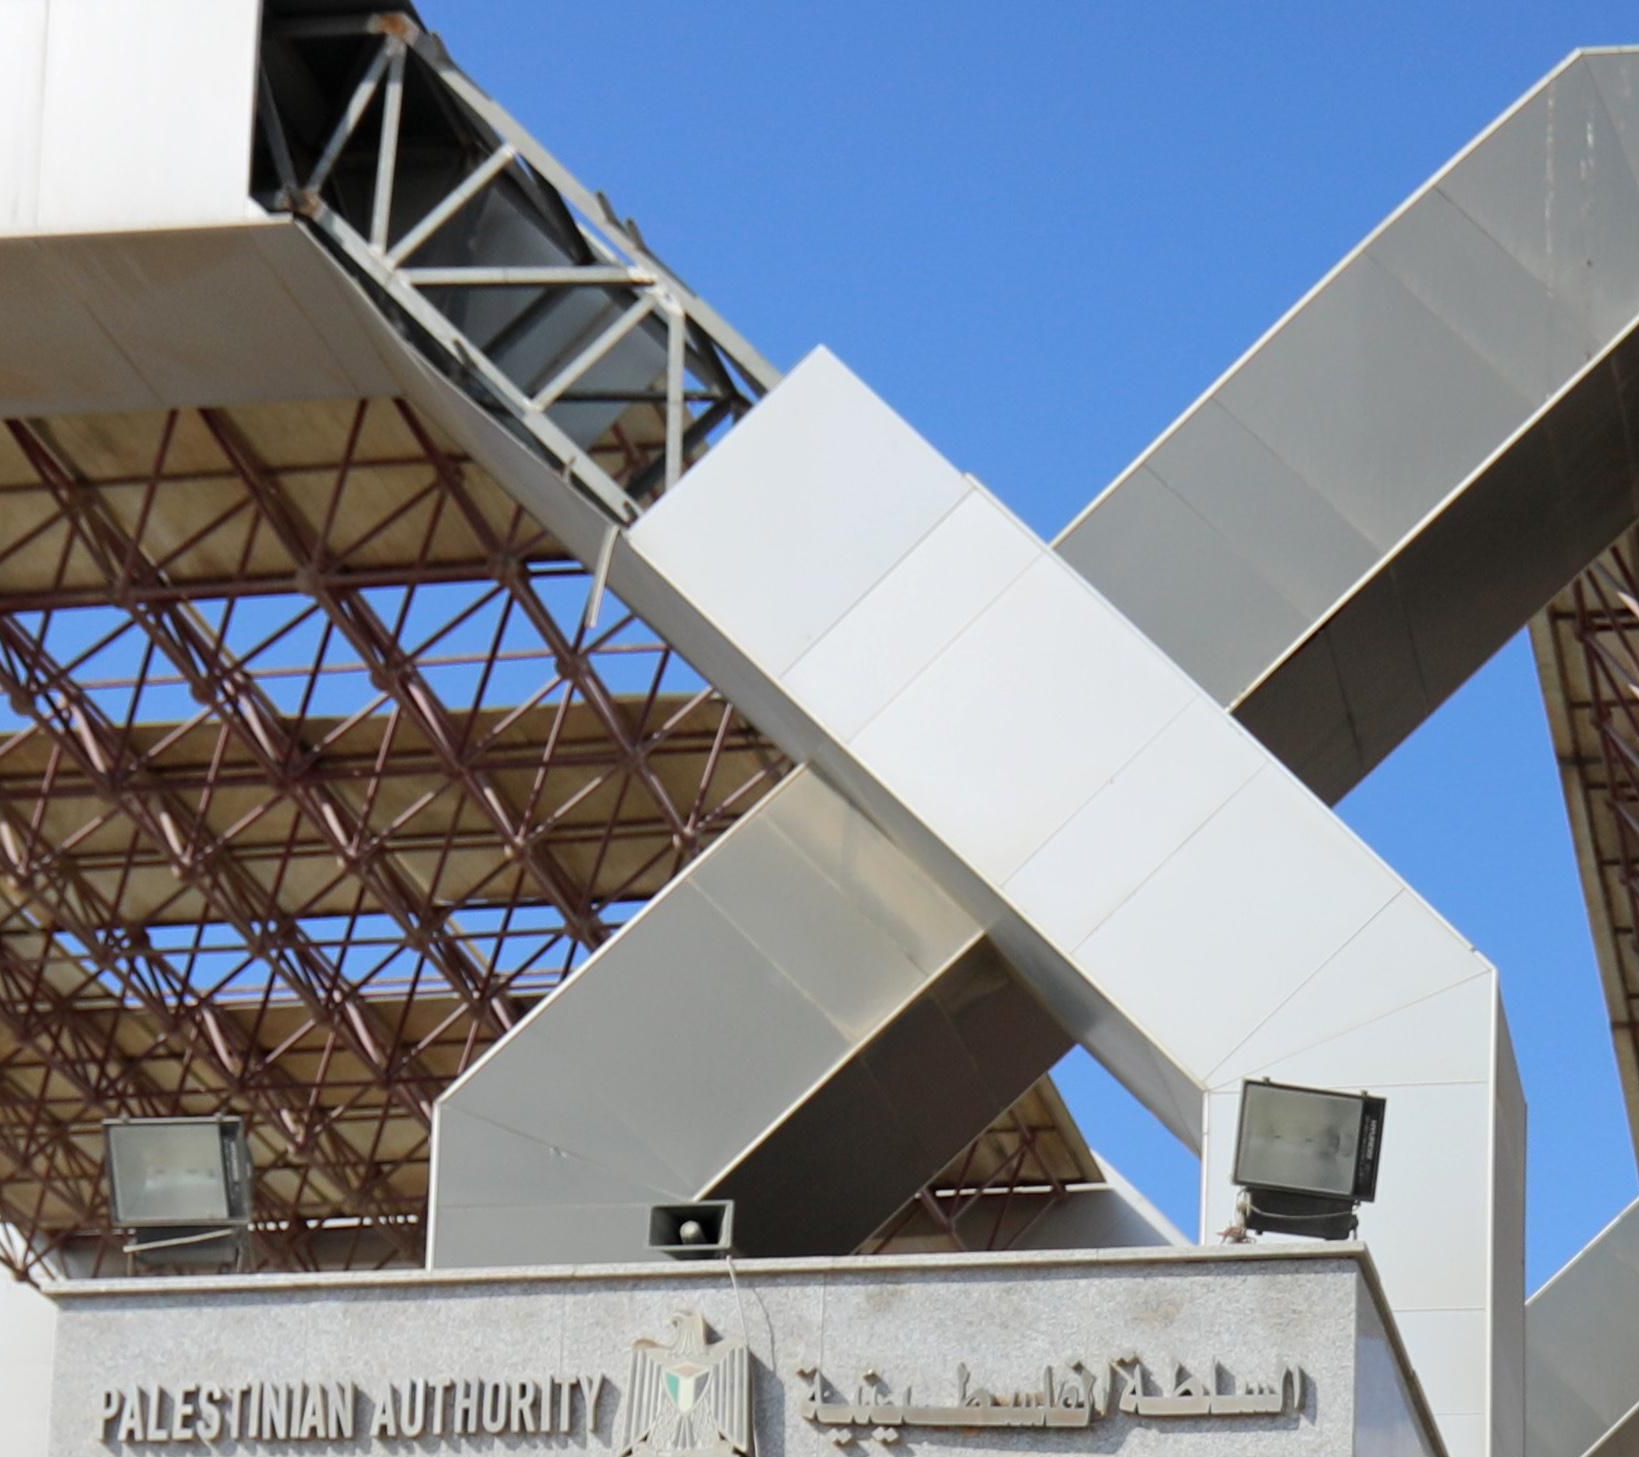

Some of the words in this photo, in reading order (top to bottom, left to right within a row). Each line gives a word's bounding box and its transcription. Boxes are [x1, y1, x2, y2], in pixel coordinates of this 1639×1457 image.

[97, 1378, 357, 1443] PALESTINIAN
[370, 1372, 606, 1438] AUTHORITY
[797, 1359, 1115, 1447] الفلسطينية
[1112, 1353, 1308, 1415] السلطة
